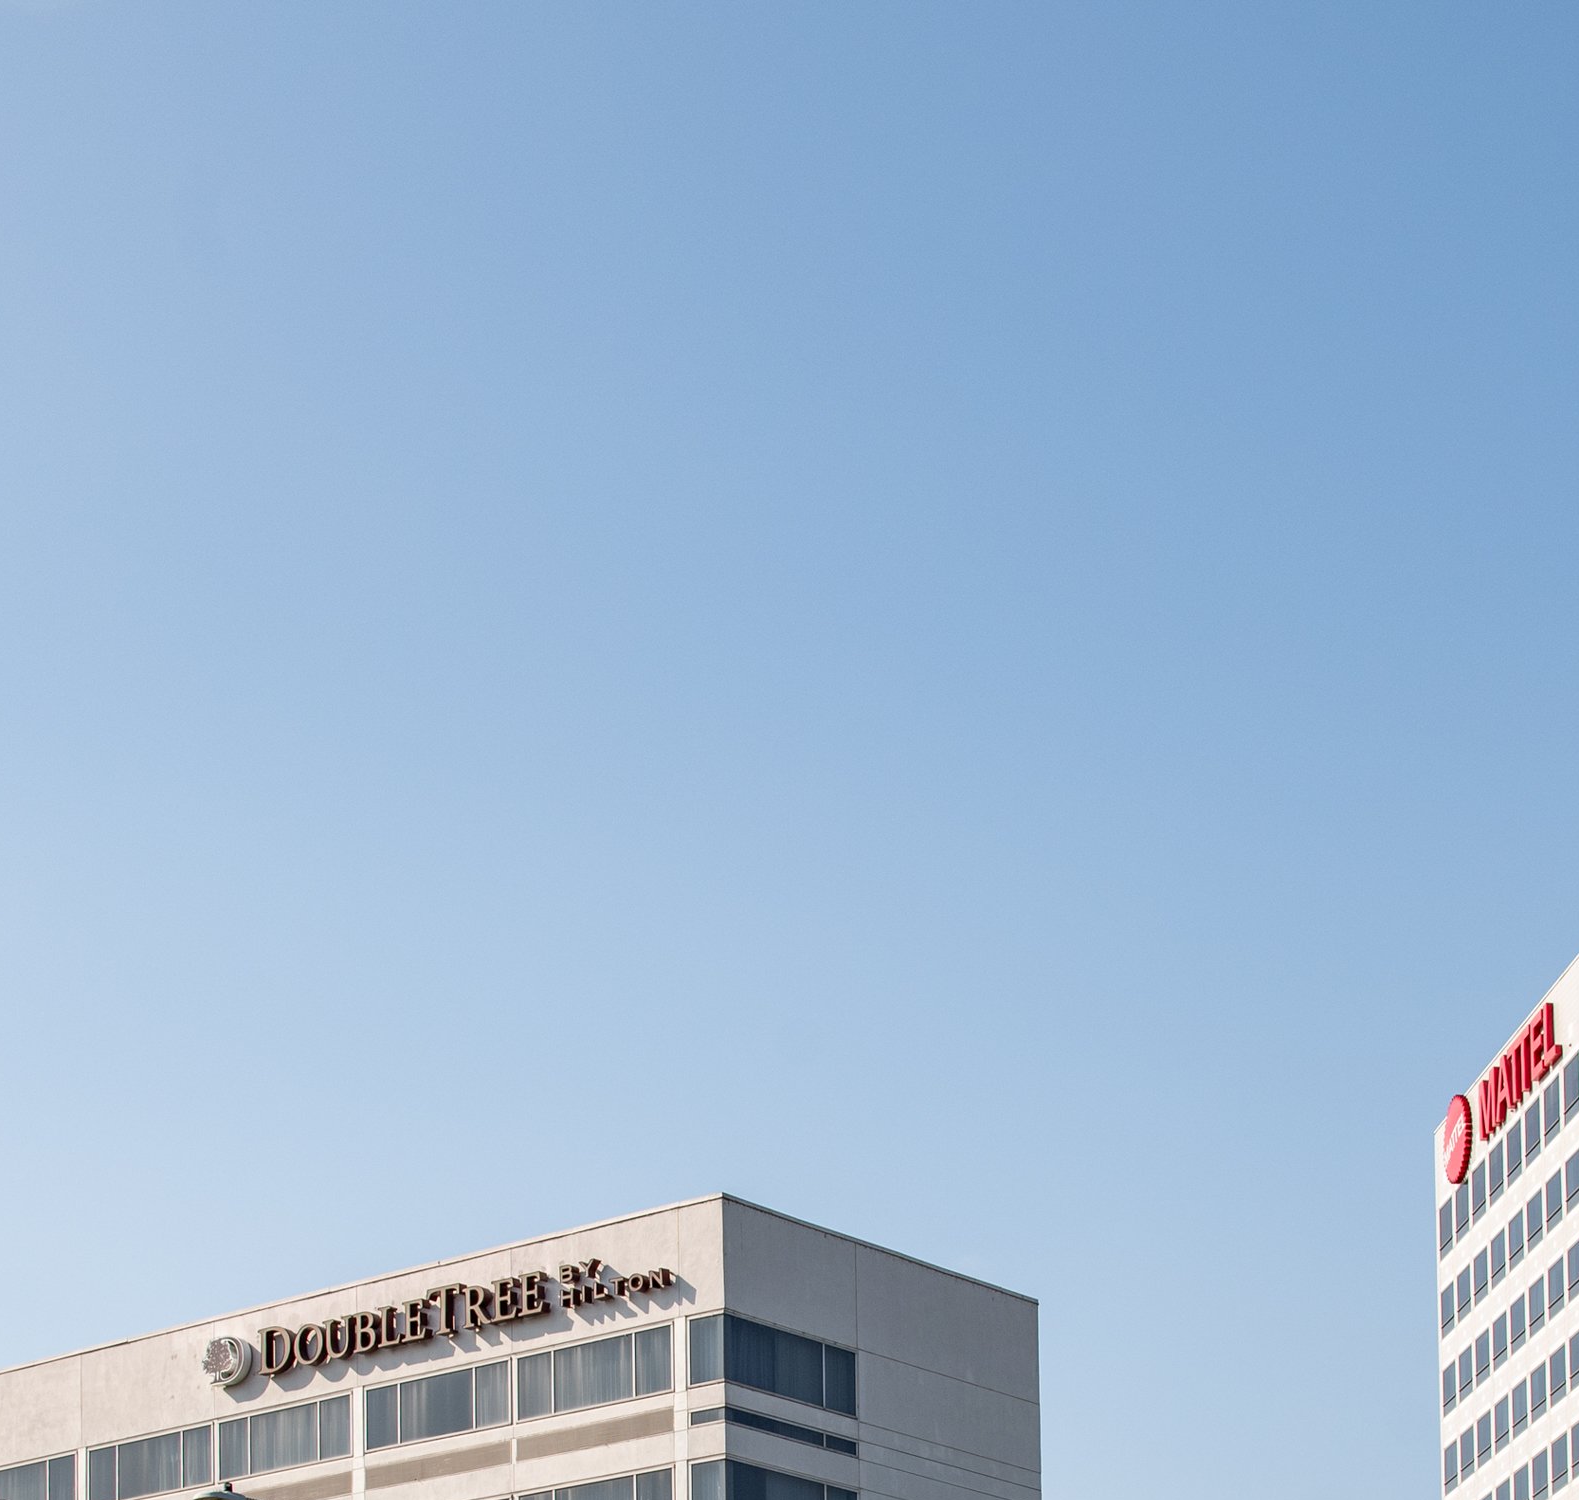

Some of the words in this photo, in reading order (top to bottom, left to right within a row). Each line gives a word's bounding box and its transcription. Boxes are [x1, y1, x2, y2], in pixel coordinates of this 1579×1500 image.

[1478, 1003, 1563, 1141] MATTEL
[559, 1258, 602, 1284] BY
[560, 1267, 672, 1308] HILTON
